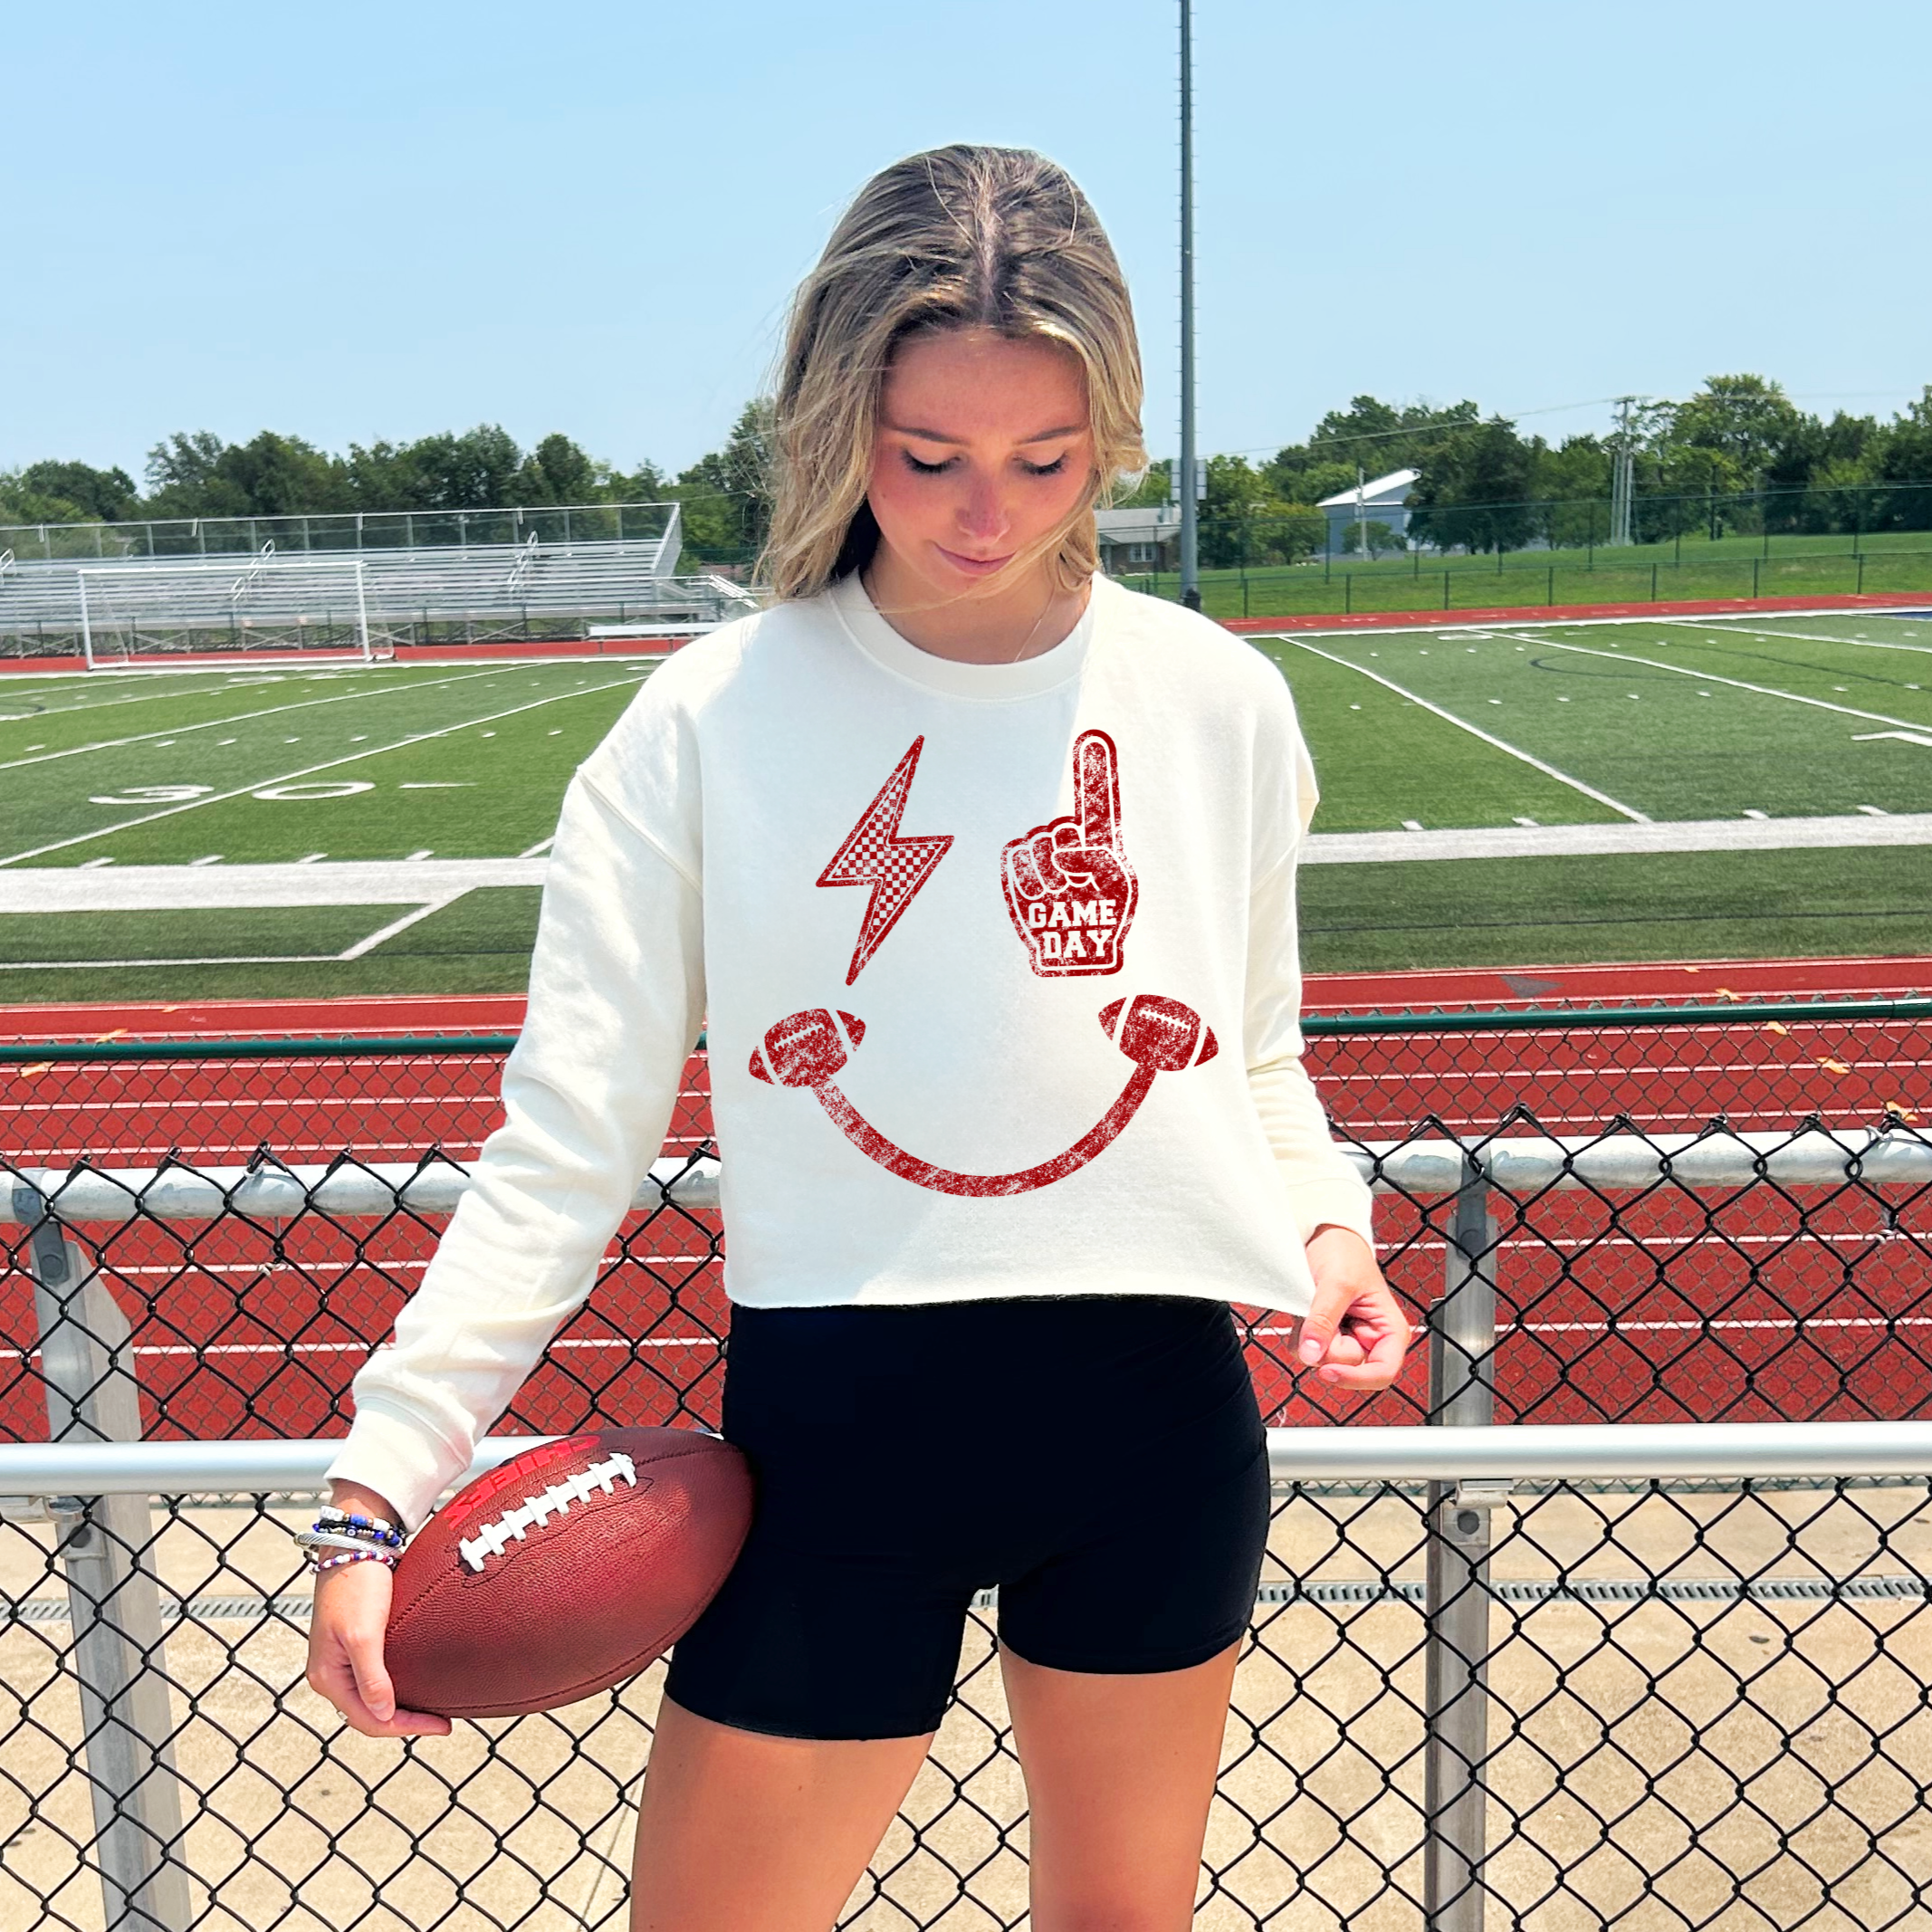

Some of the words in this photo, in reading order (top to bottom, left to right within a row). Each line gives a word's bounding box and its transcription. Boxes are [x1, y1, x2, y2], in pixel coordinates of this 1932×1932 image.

[1028, 900, 1116, 928] GAME
[1043, 930, 1113, 959] DAY
[444, 1436, 600, 1529] CHIEFS
